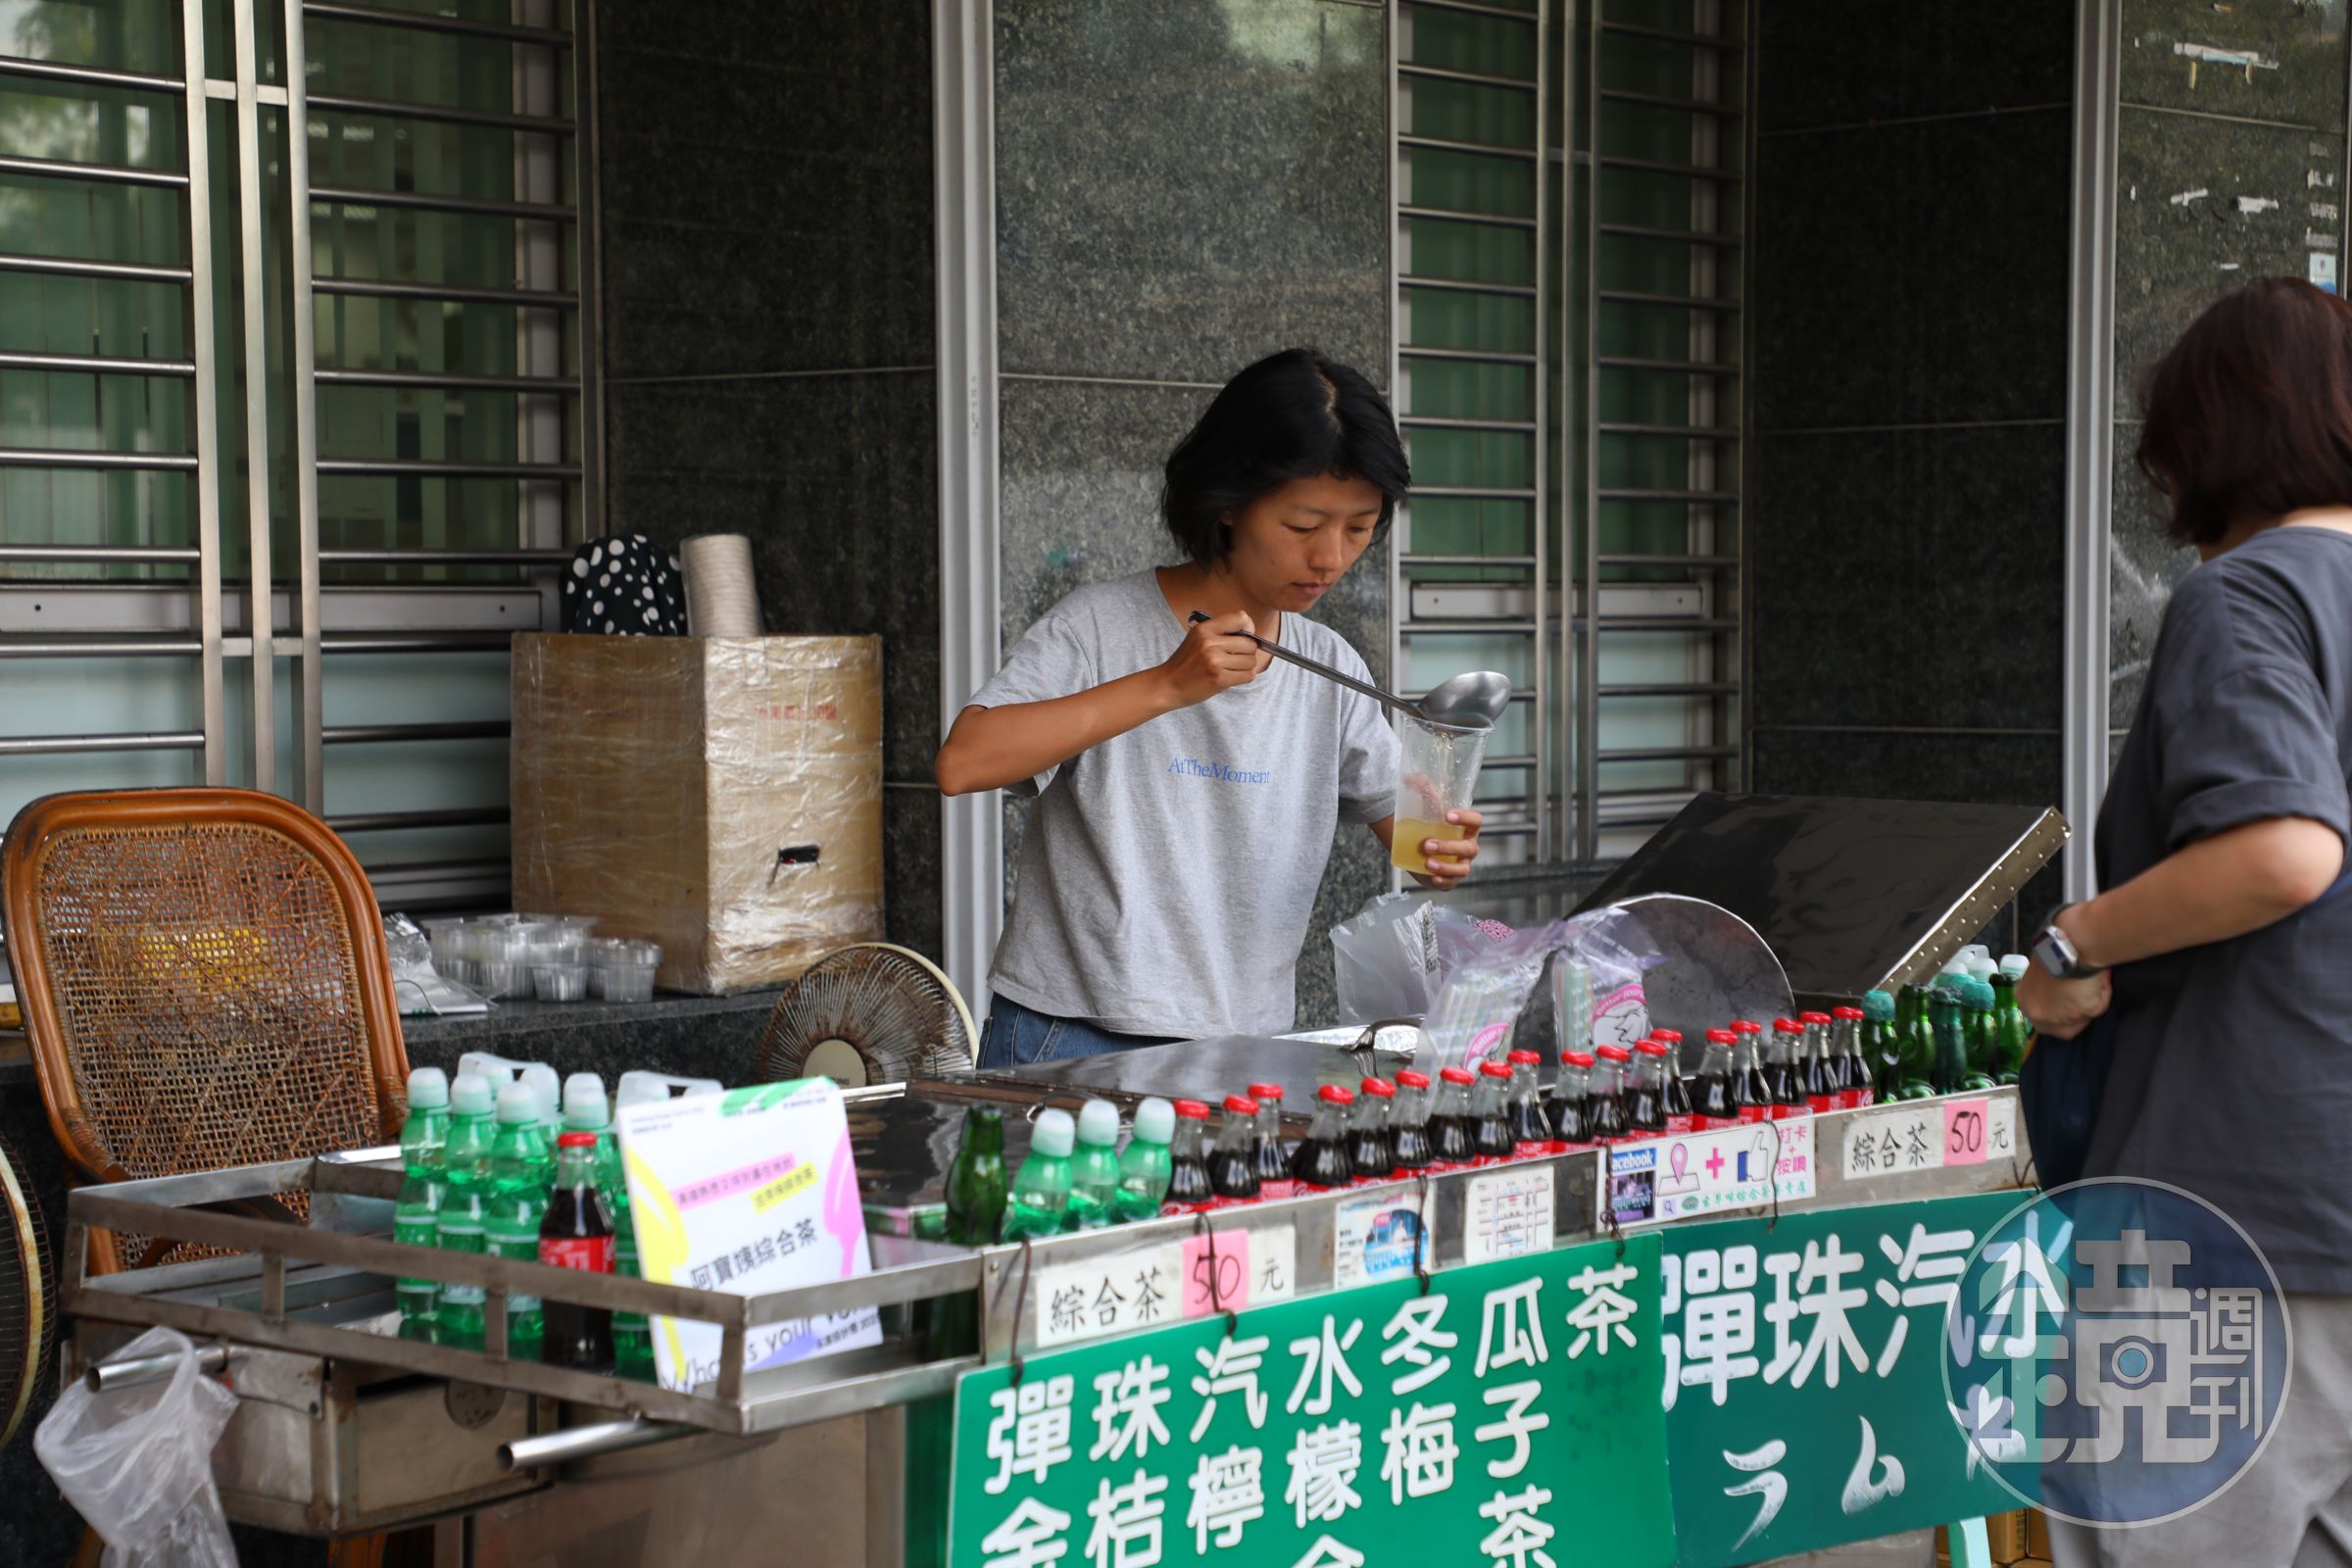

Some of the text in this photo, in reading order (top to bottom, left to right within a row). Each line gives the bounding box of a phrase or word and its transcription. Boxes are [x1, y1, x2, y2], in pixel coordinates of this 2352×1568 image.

[1167, 757, 1271, 783] AtTheMoment
[1610, 1150, 1654, 1172] acebook
[1851, 1110, 2010, 1172] 綜合茶 50 元
[1050, 1253, 1285, 1335] 綜合茶 50 元
